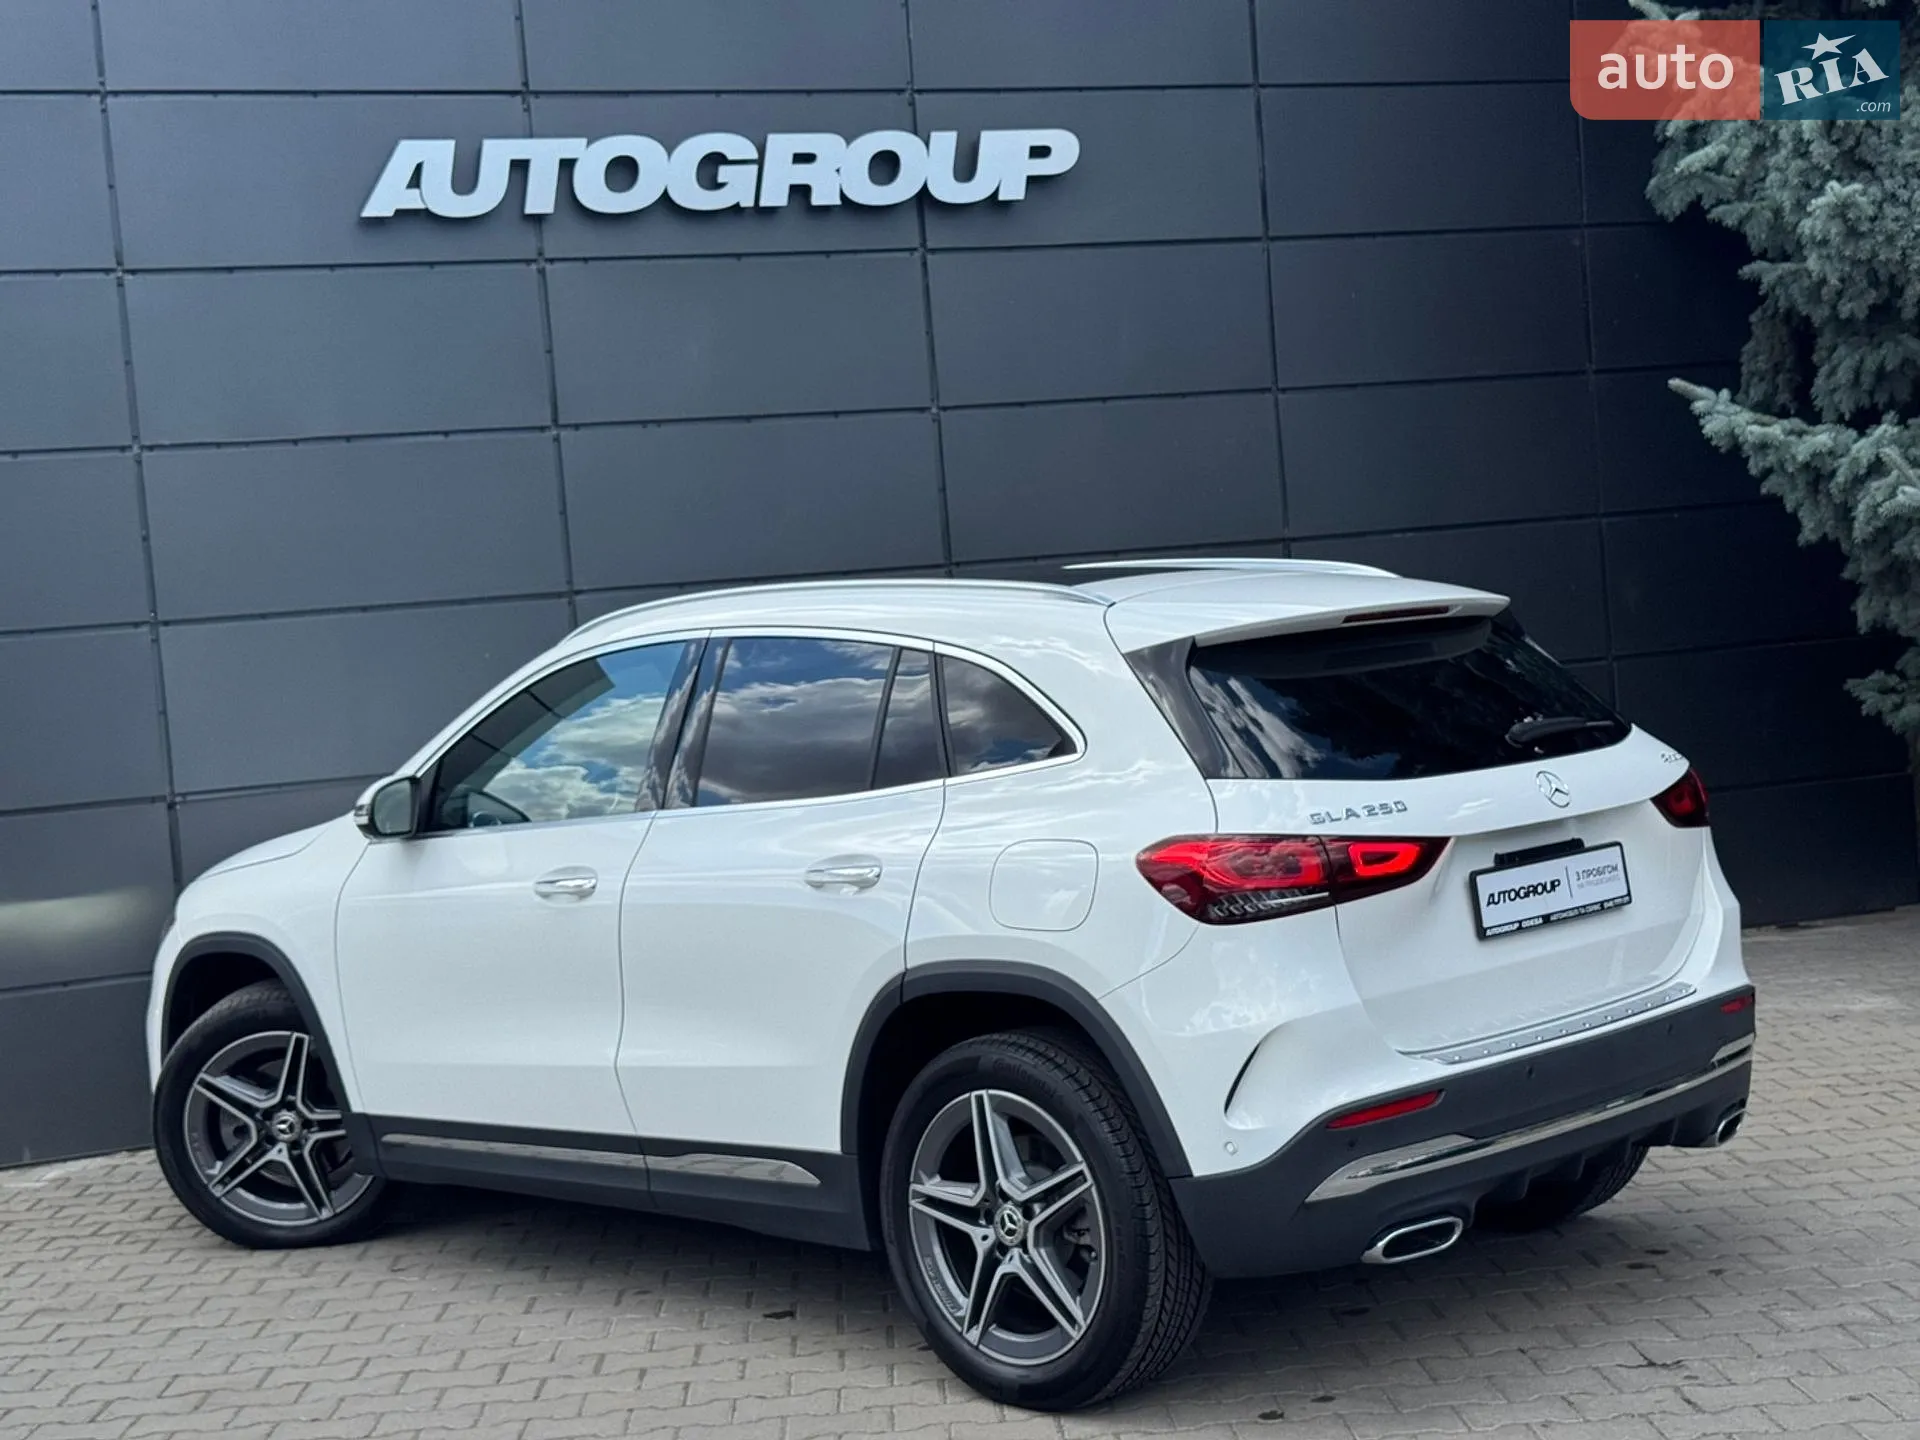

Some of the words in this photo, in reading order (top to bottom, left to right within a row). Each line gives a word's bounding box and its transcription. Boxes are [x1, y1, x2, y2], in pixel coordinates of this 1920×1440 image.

[360, 127, 1081, 219] AUTOGROUP
[1308, 806, 1361, 826] GLA
[1361, 799, 1408, 818] 250
[1486, 878, 1562, 907] AUTOGROUP
